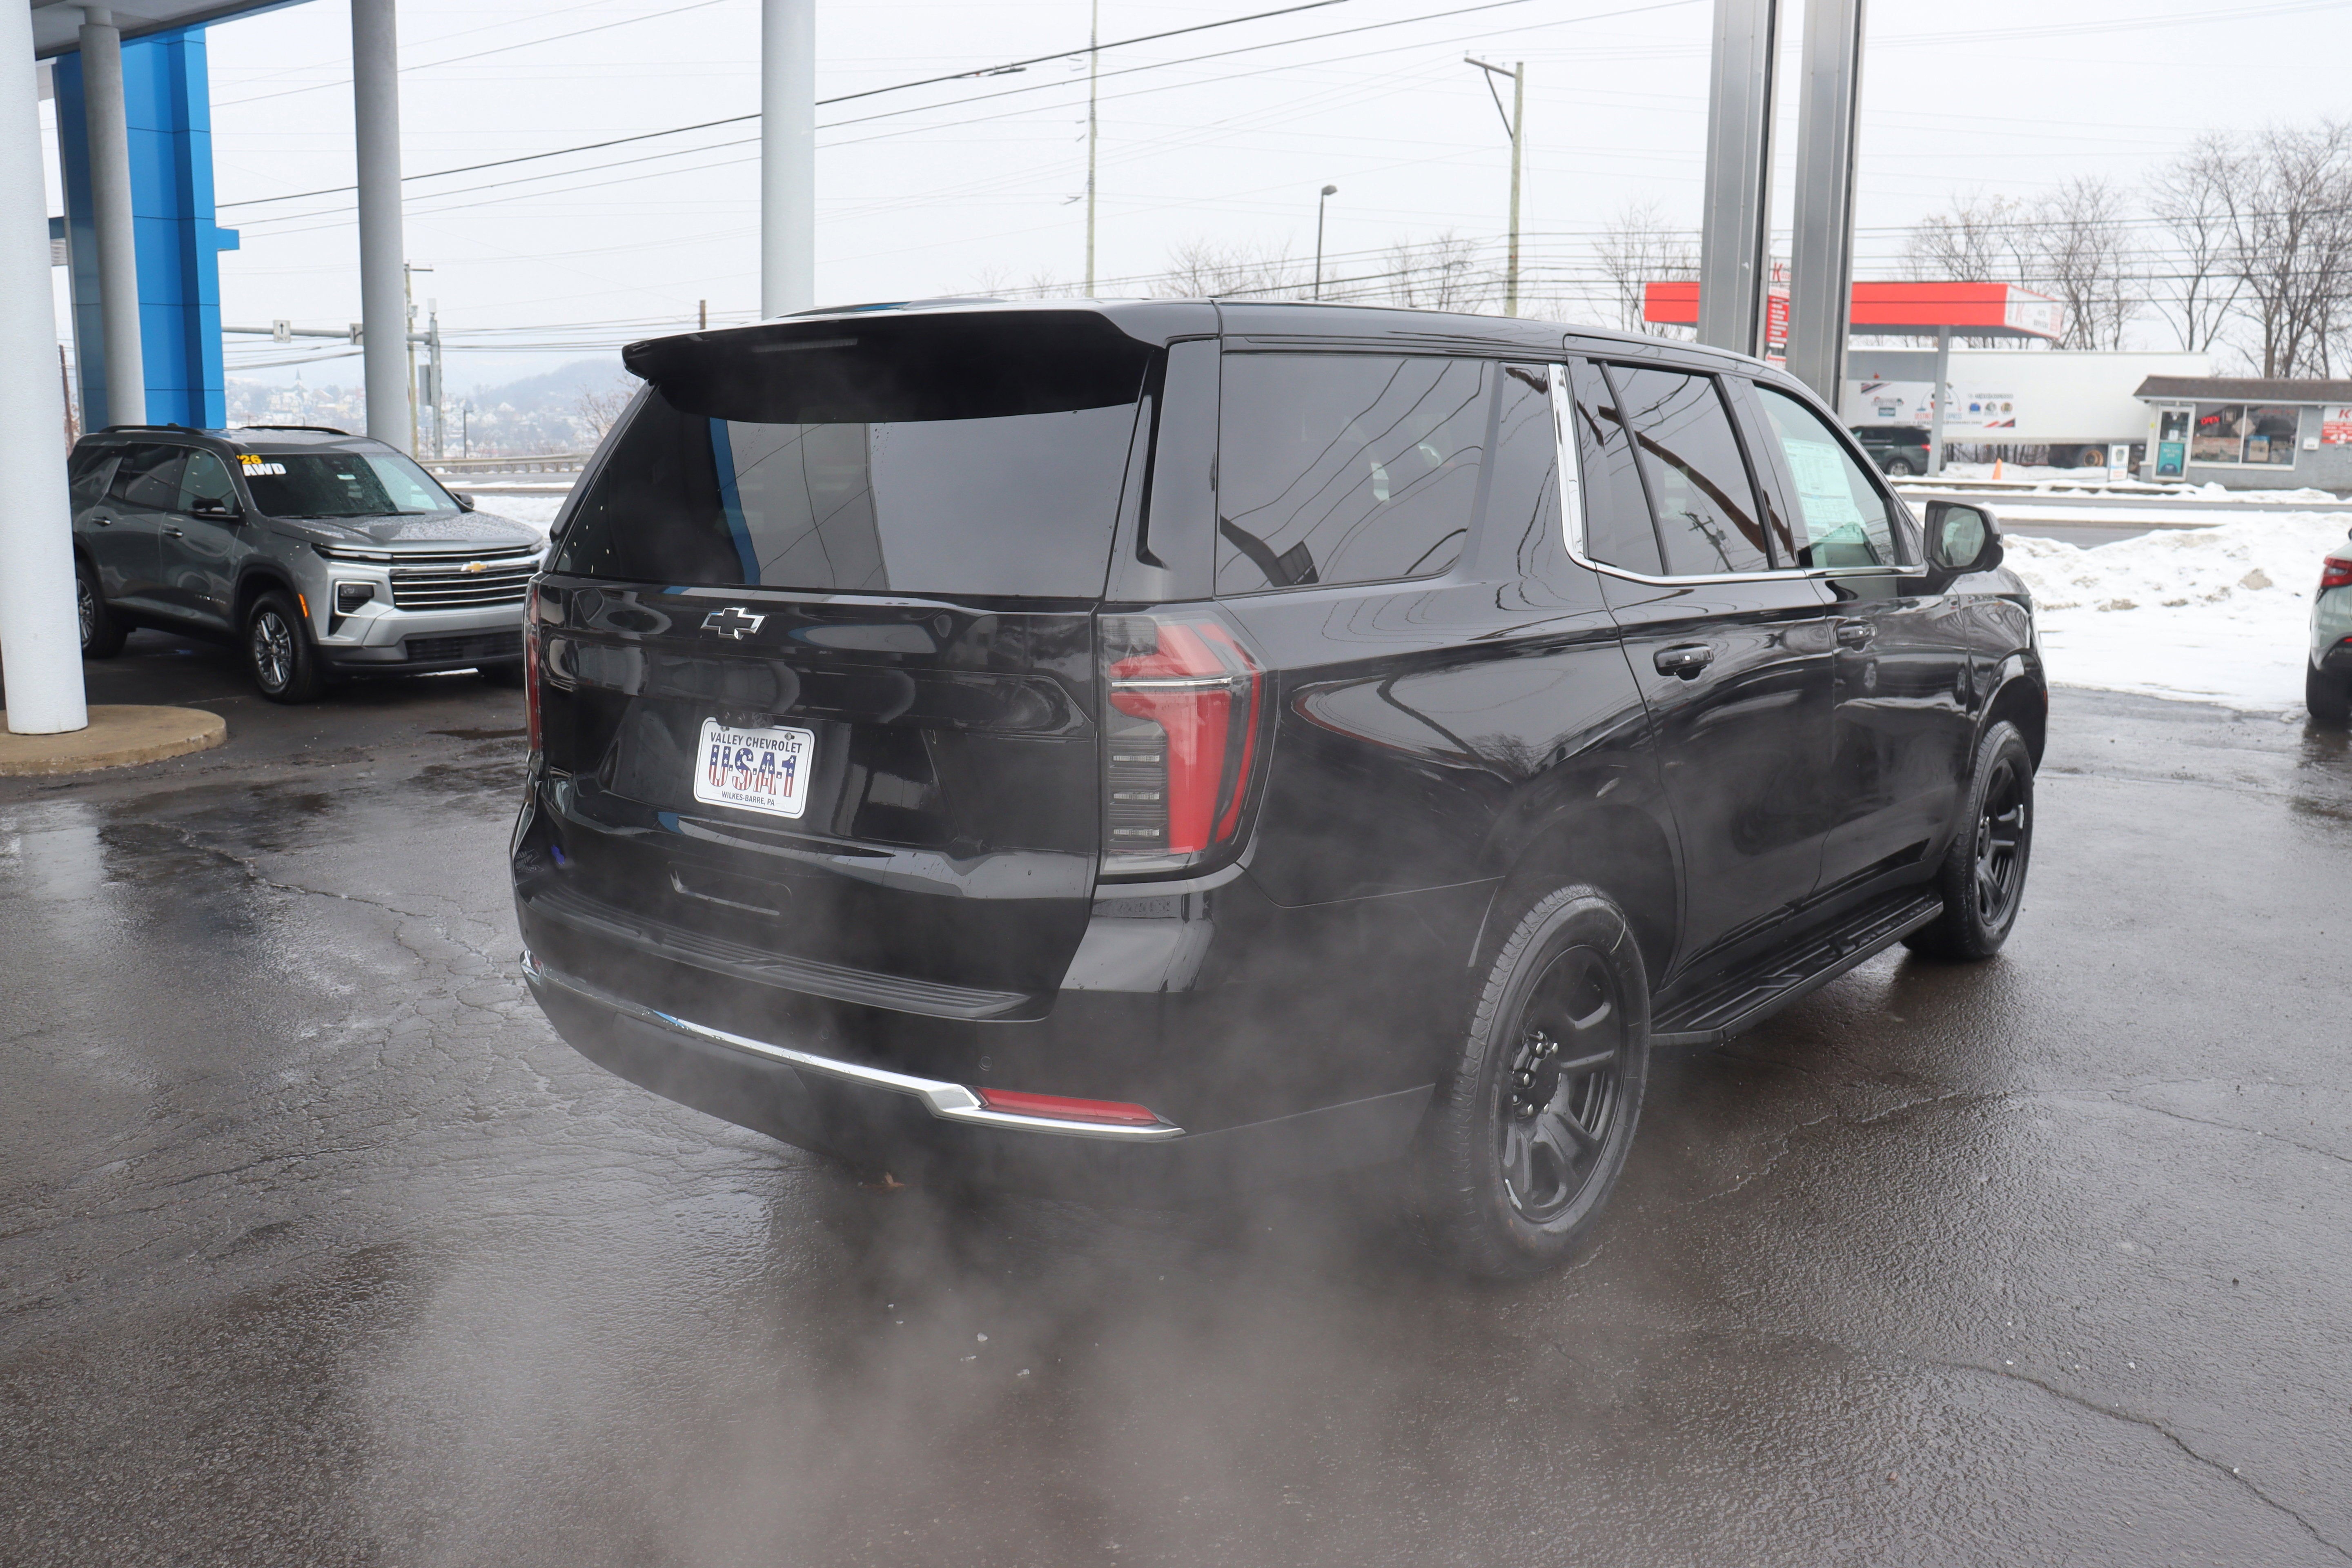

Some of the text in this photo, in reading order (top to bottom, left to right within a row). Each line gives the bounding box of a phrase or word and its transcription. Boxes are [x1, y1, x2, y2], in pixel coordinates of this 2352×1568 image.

[2200, 416, 2220, 425] OPEN
[242, 463, 286, 477] AWD
[710, 732, 802, 753] VALLEY CHEVROLET
[722, 791, 766, 806] WILKES-BARRE,
